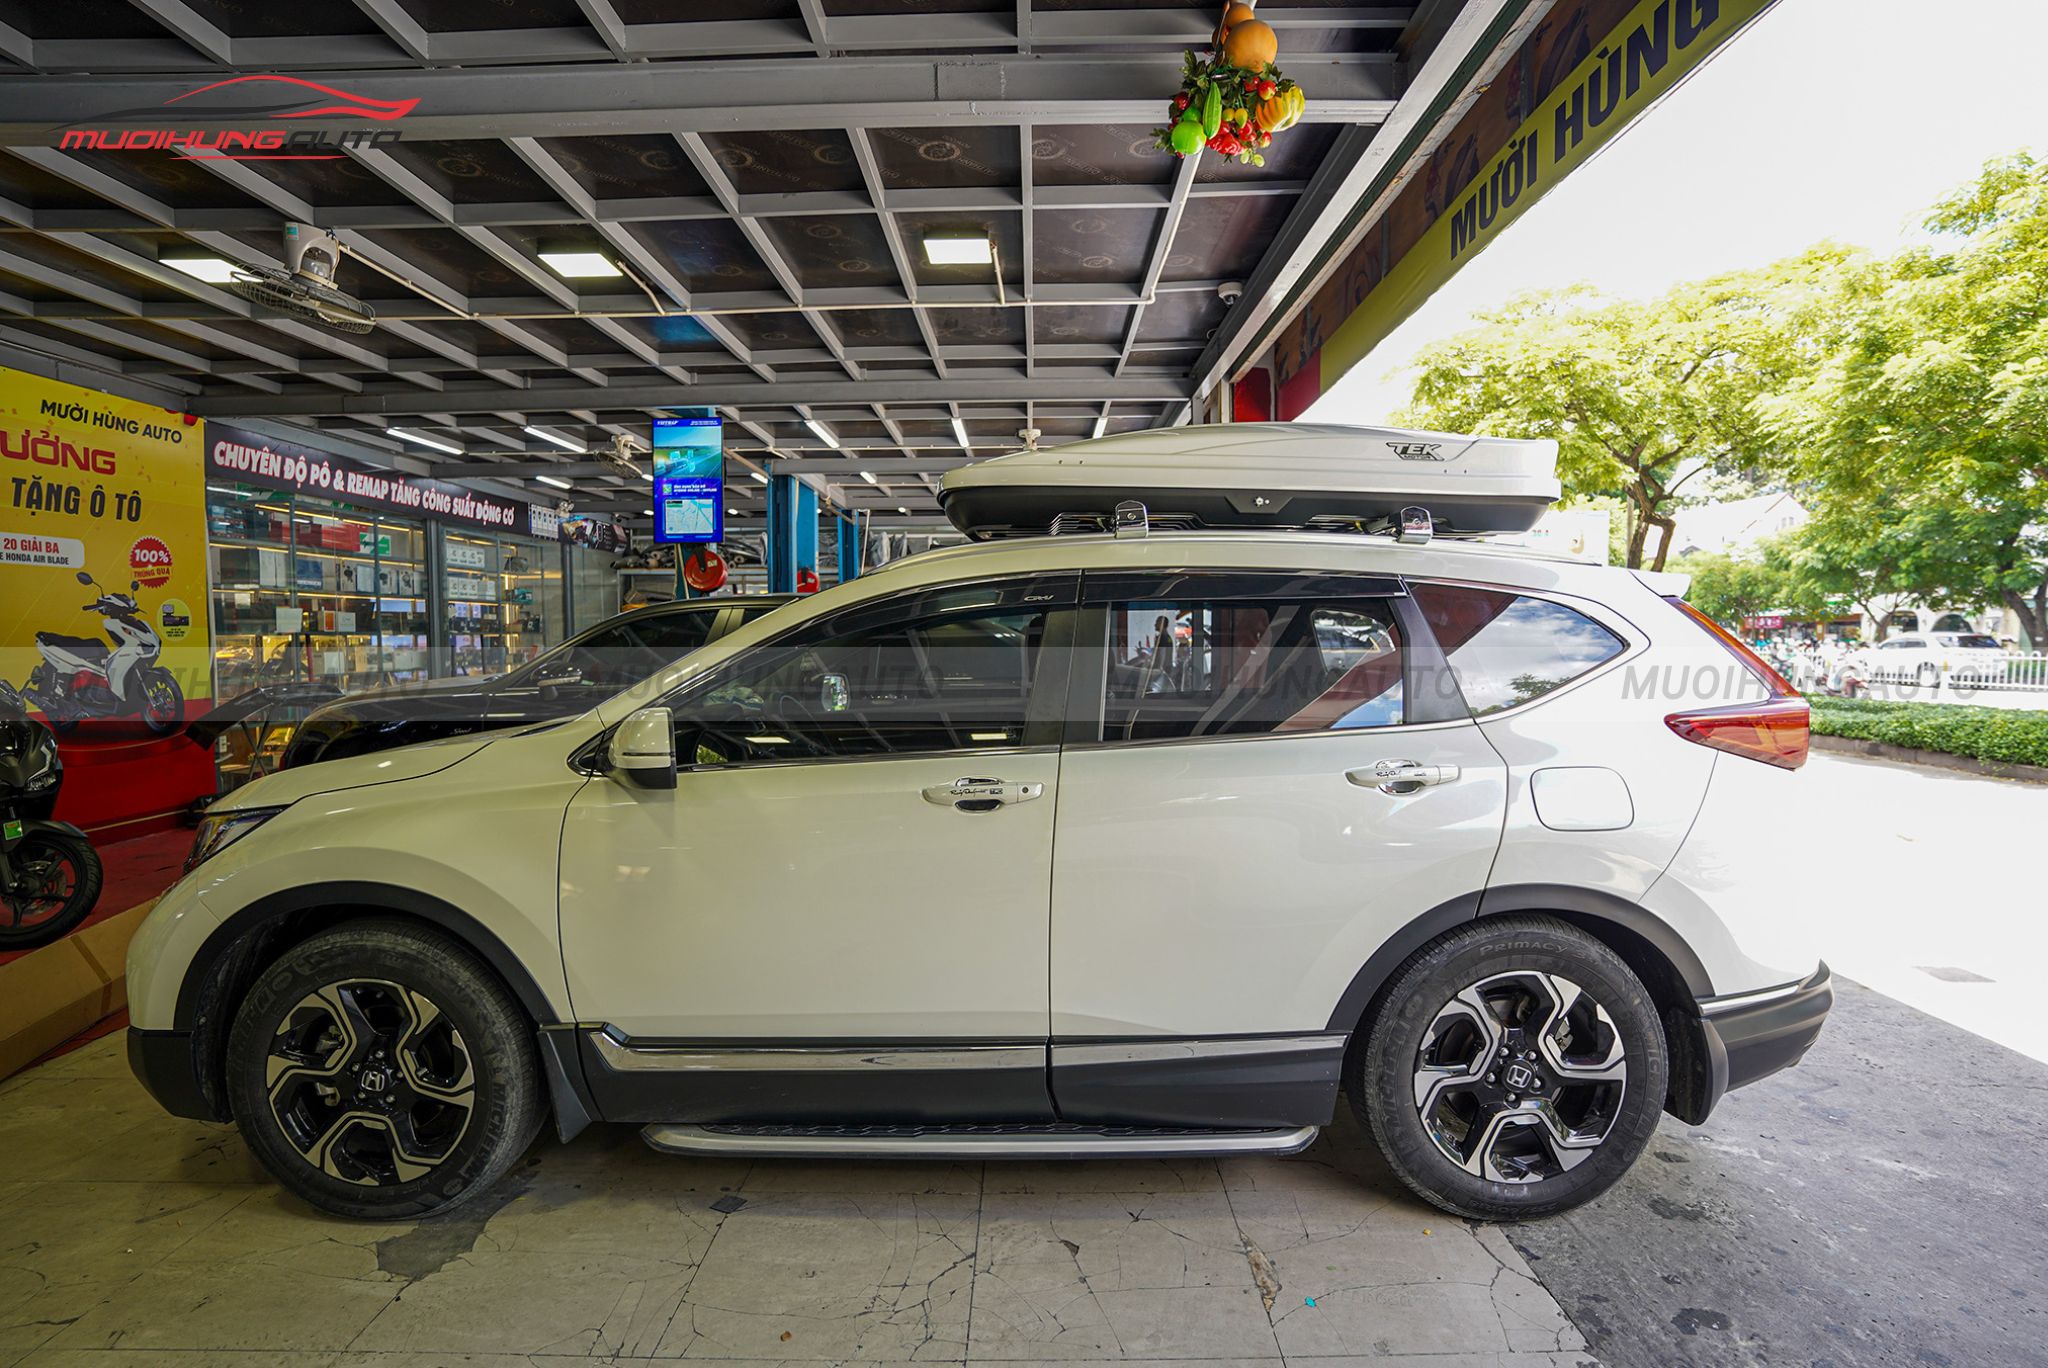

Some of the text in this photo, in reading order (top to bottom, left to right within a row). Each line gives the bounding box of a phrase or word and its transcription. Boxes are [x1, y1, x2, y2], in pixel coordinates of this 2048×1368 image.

[1450, 128, 1538, 261] MƯỜI
[40, 399, 183, 444] MƯỜI HÙNG AUTO
[1385, 442, 1445, 461] TEK
[11, 474, 142, 522] TẶNG Ô TÔ
[213, 440, 515, 526] CHUYÊN ĐỘ PÔ & REMAP TĂNG CÔNG SUẤT ĐỘNG CƠ
[3, 536, 60, 554] 20 GIẢI BA
[5, 553, 32, 563] HONDA
[33, 554, 46, 564] AIR
[47, 555, 69, 566] BLADE
[134, 548, 170, 564] 100%
